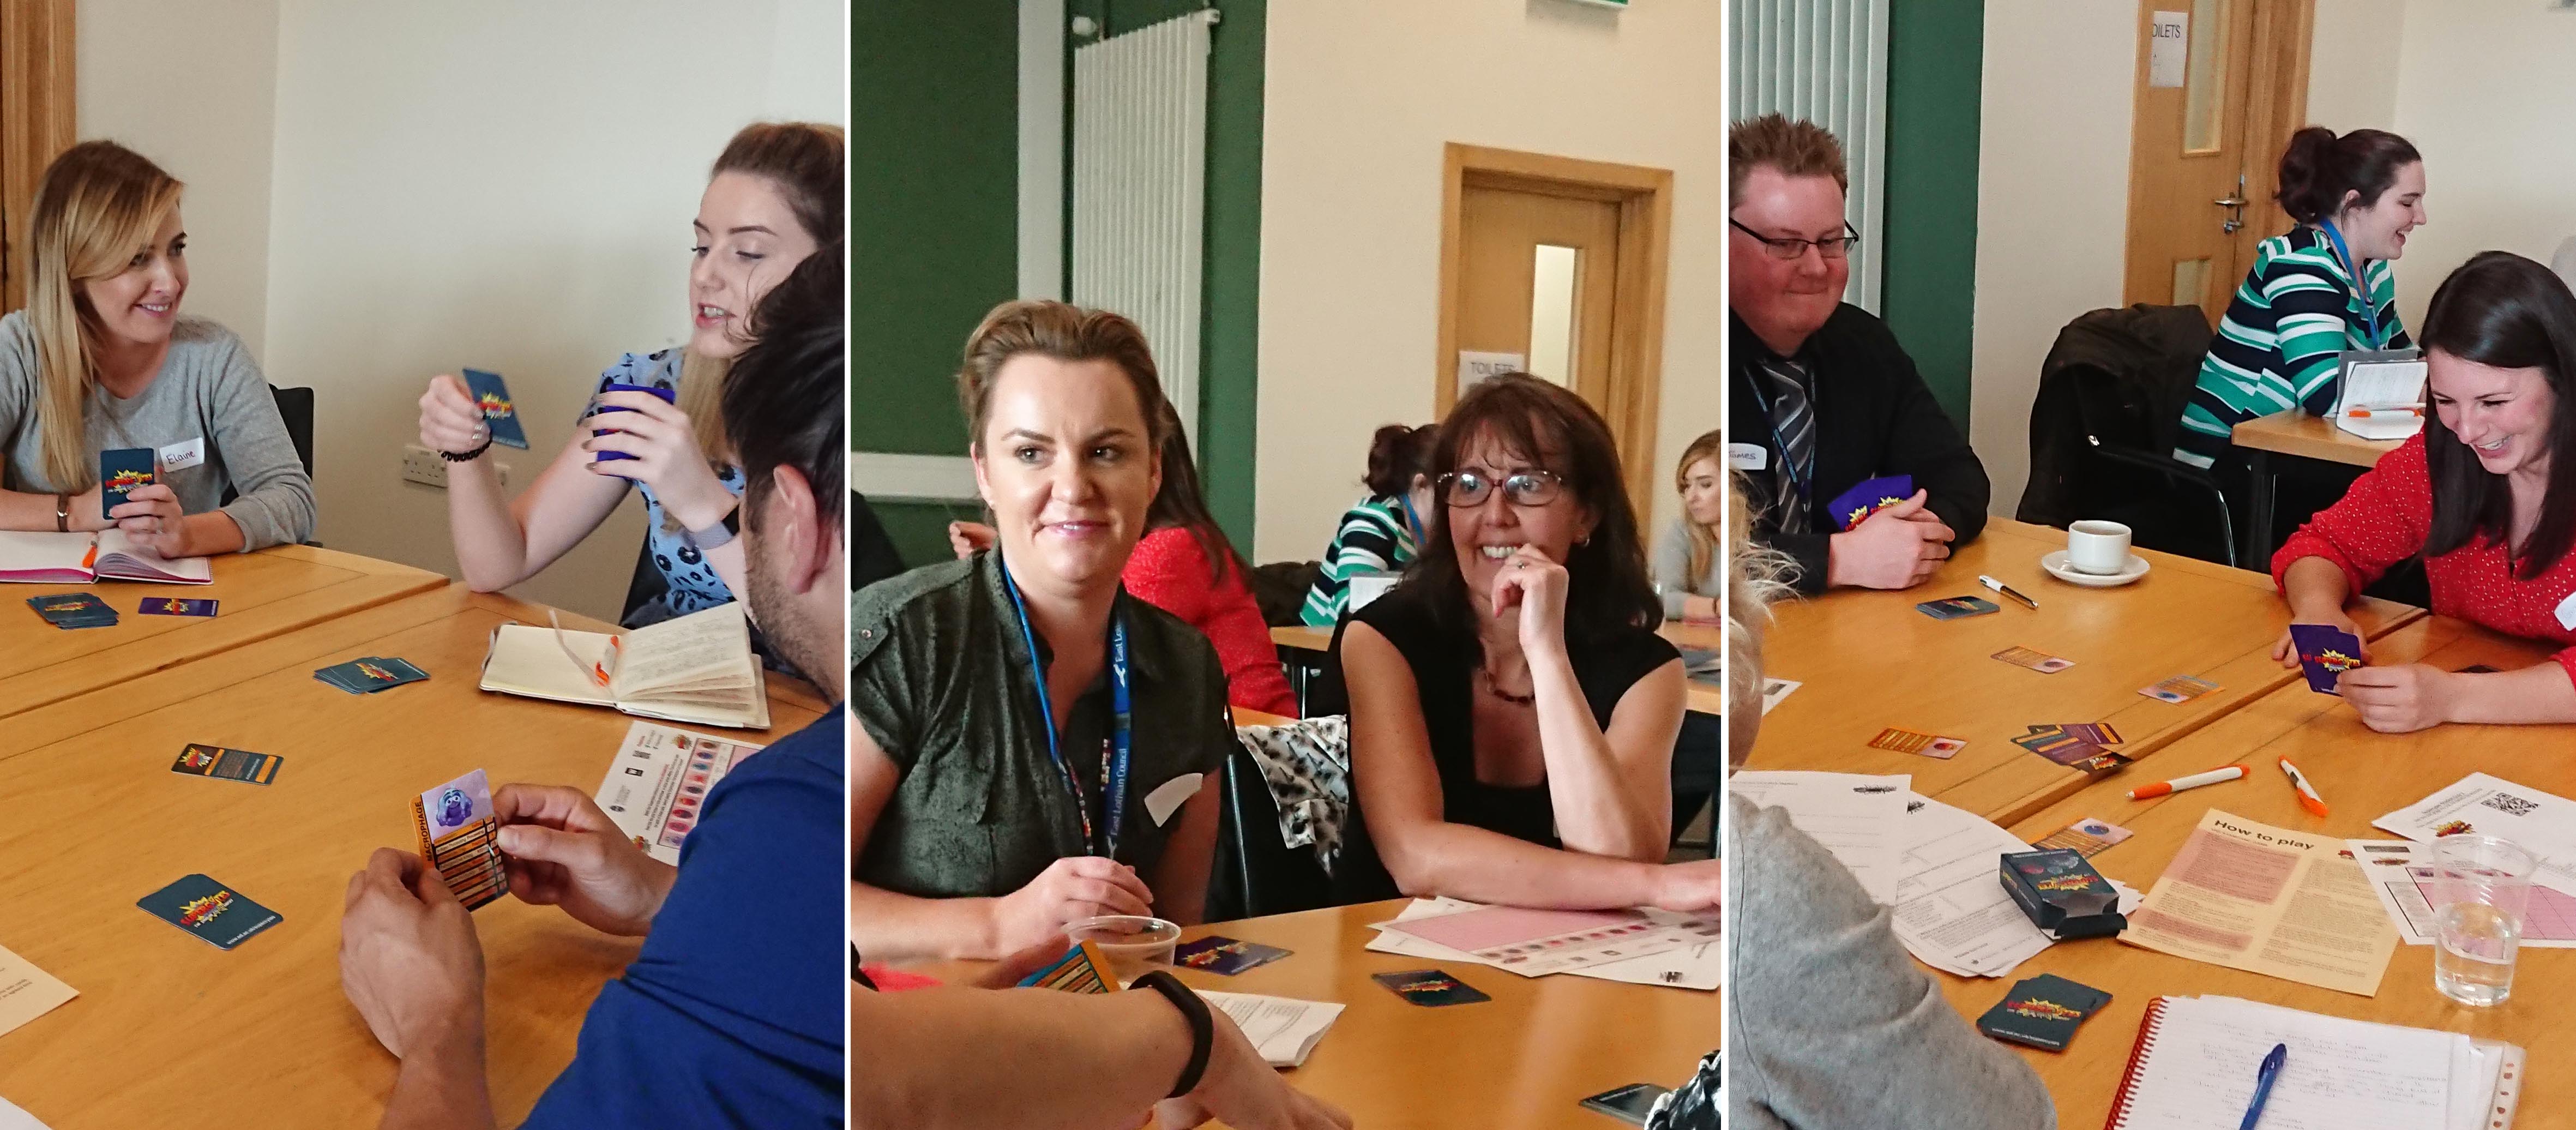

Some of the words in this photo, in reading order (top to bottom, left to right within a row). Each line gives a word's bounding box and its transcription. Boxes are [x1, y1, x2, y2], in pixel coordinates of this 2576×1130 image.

[166, 450, 195, 464] Elaine
[1116, 748, 1127, 777] Council
[415, 801, 433, 861] MACROPHAGE
[2214, 820, 2252, 836] How
[2257, 833, 2273, 841] to
[2277, 839, 2315, 850] play
